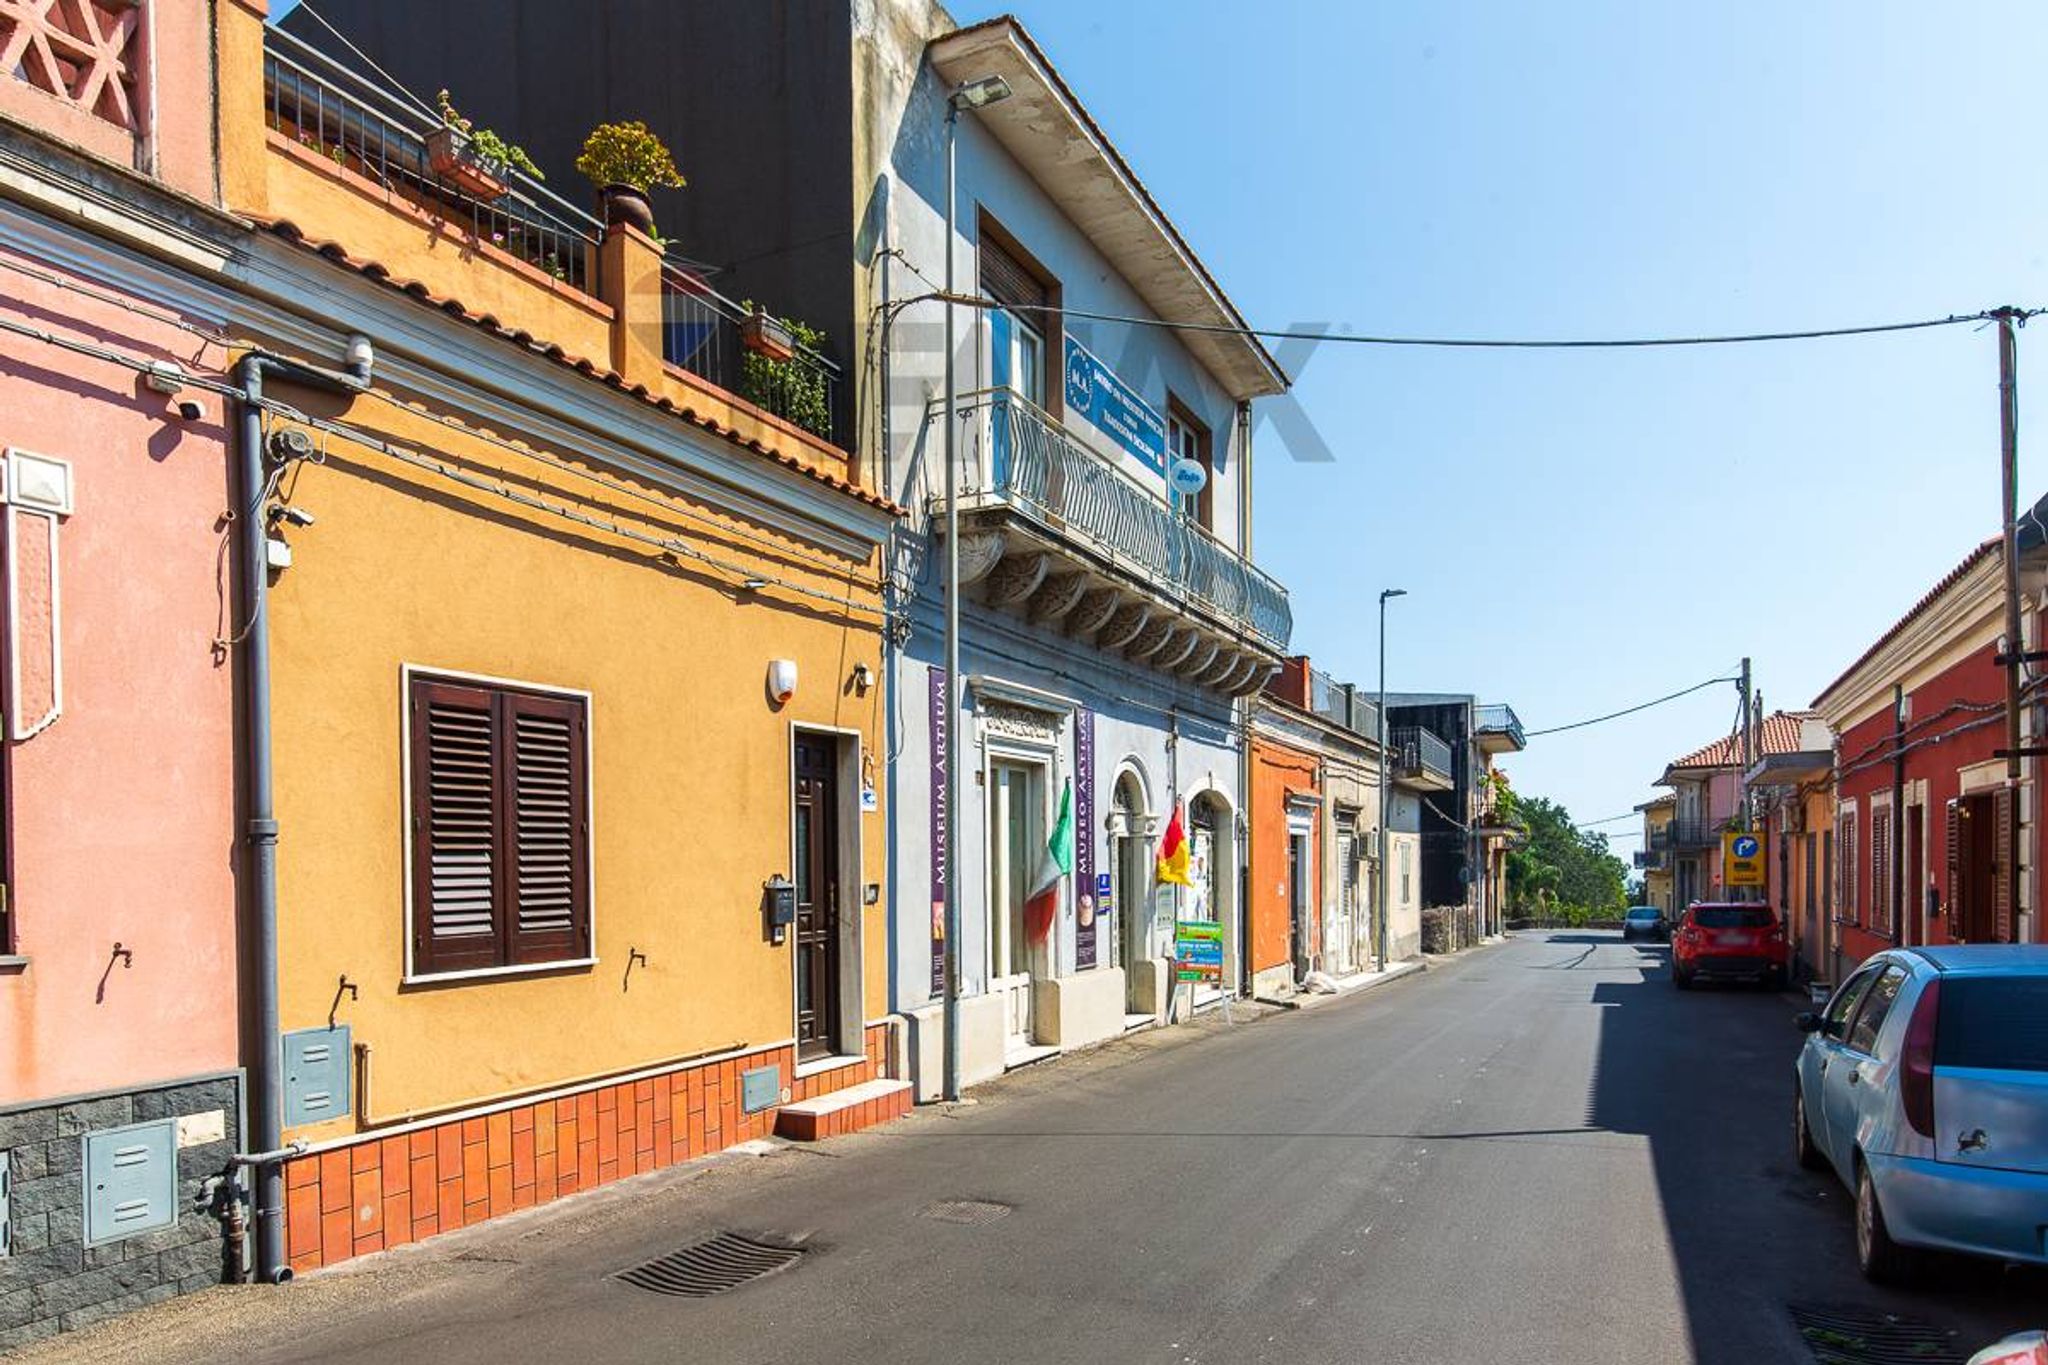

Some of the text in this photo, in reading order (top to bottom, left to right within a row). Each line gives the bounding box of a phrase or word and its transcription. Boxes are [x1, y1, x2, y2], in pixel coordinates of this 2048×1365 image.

[935, 682, 946, 884] MUSEUM ARTIUM
[1078, 711, 1087, 874] MUSEO ARTIUM
